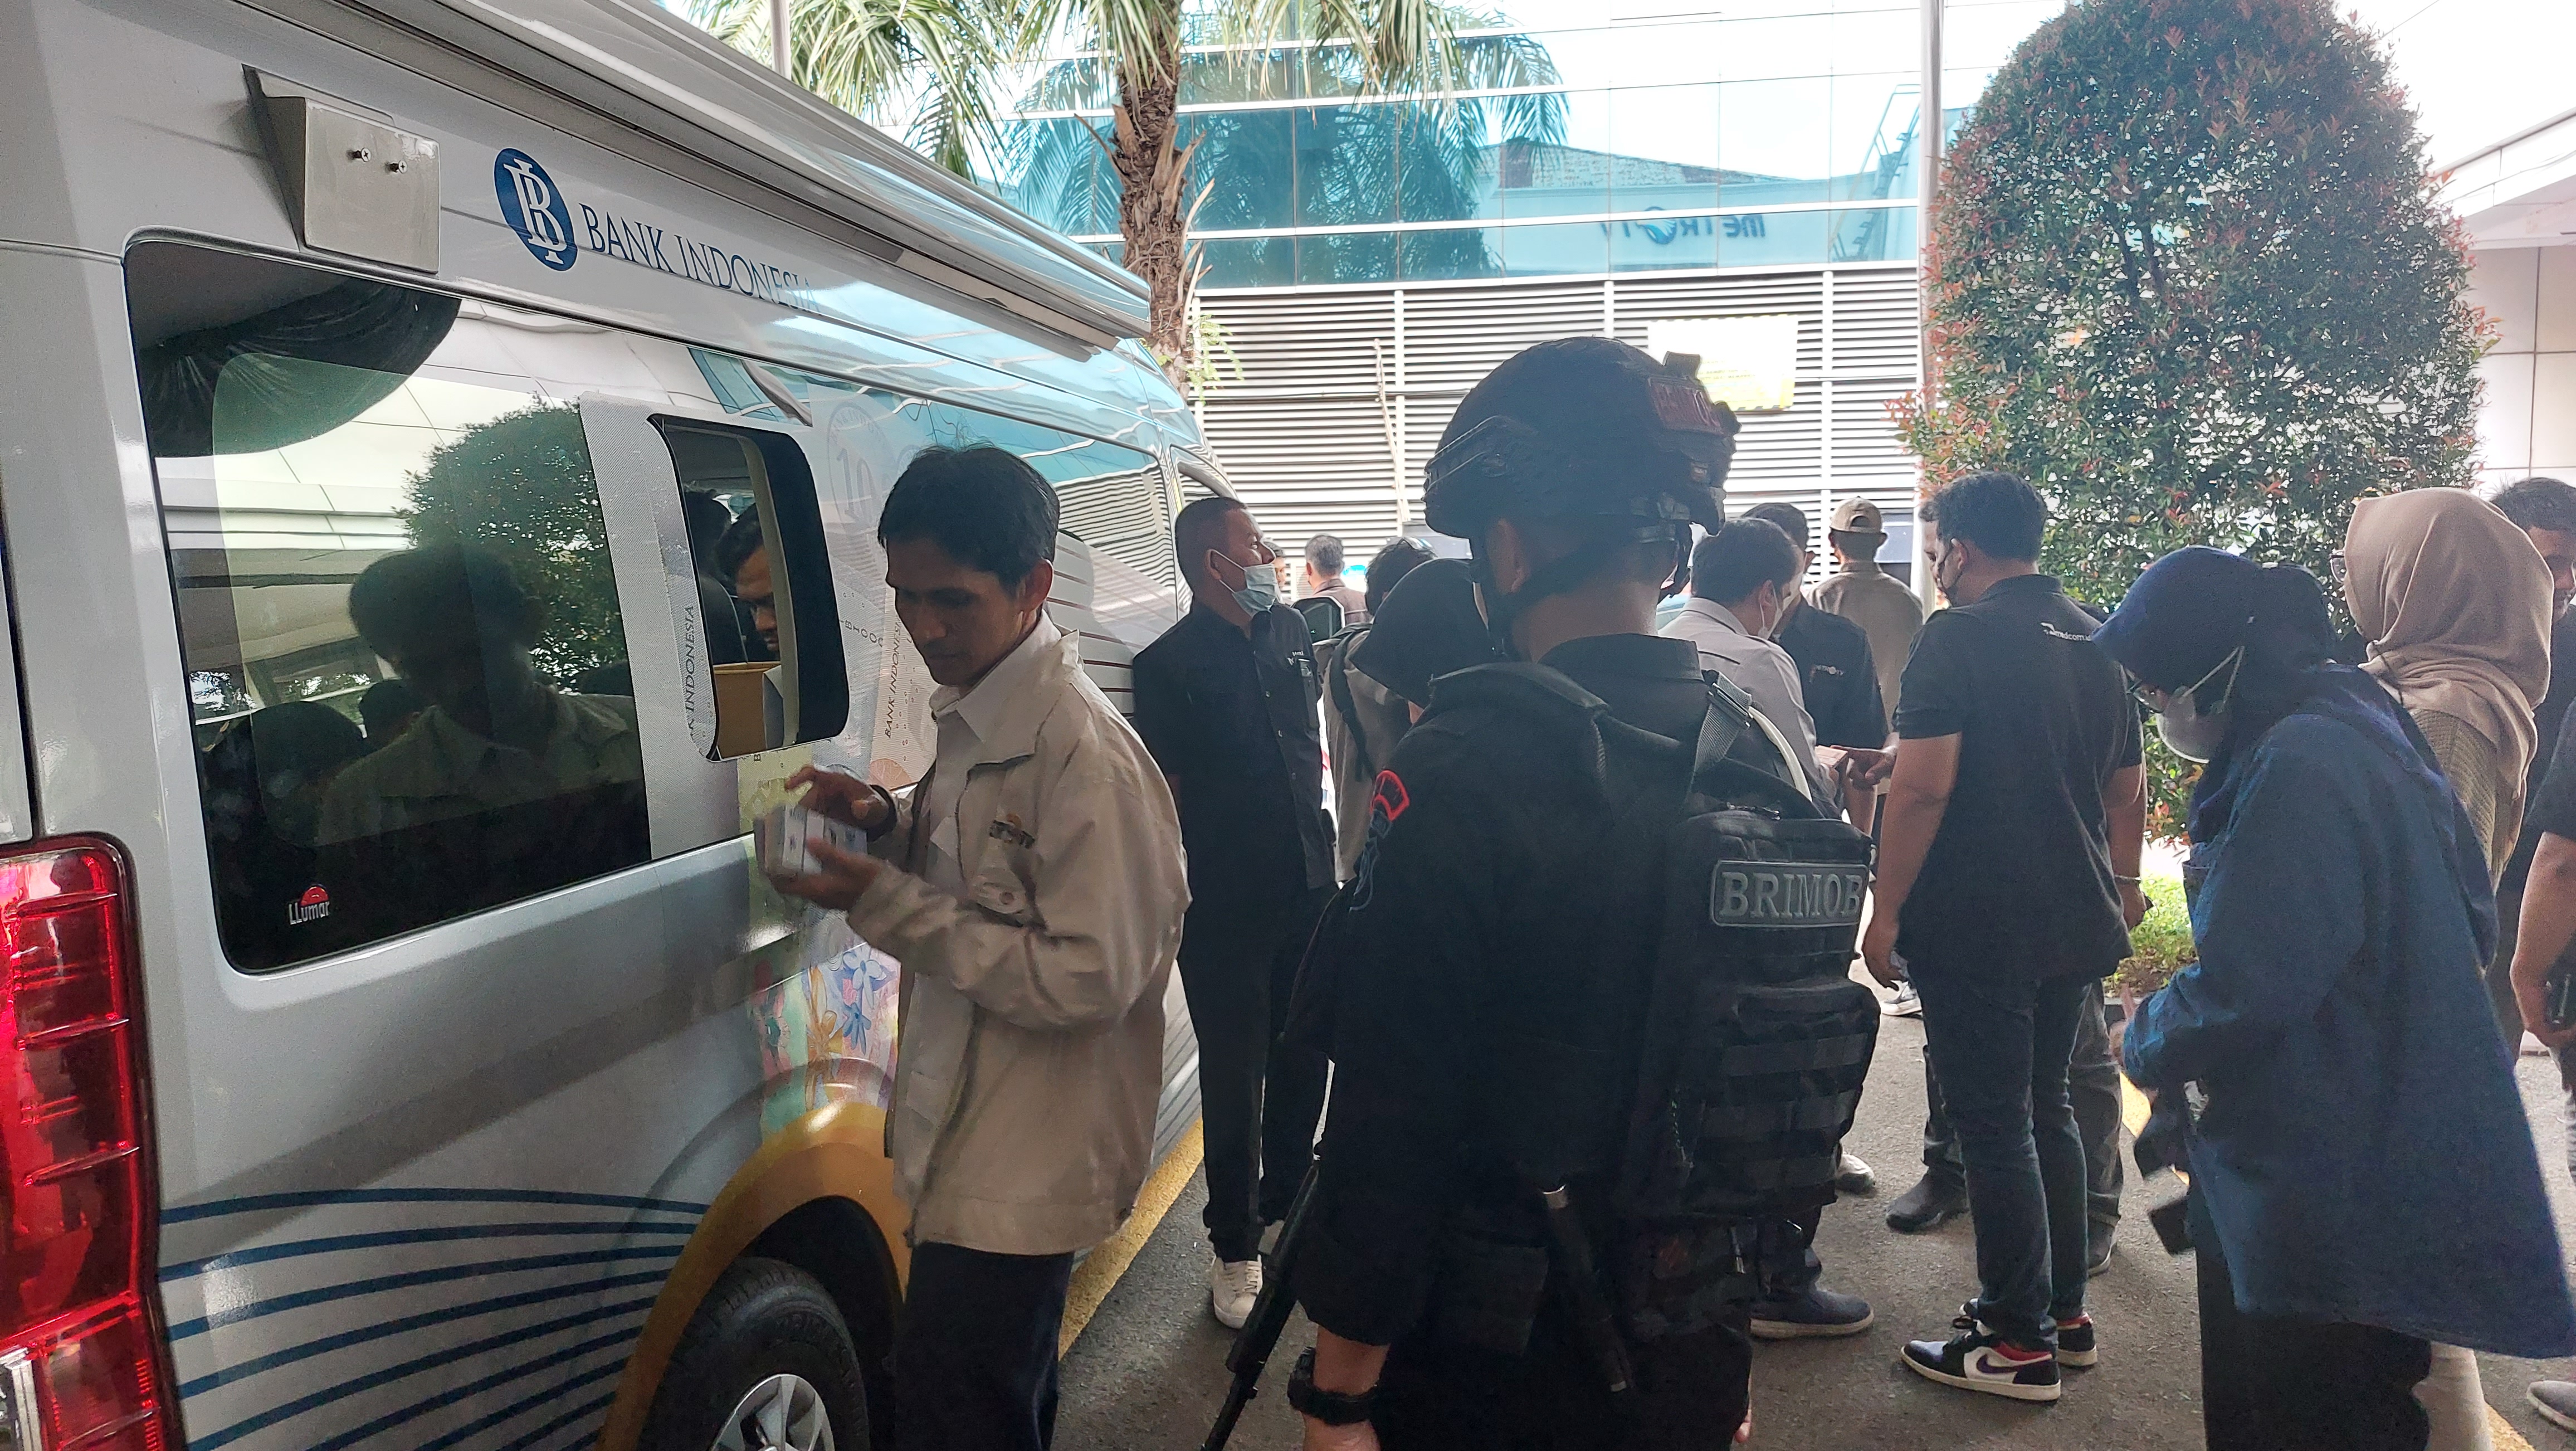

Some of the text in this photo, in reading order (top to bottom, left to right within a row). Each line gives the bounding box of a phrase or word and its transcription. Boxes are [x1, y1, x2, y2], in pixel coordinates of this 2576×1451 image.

[579, 202, 822, 313] BANK INDONESIA
[684, 605, 695, 713] INDONESIA
[884, 696, 895, 739] BANK
[287, 900, 330, 926] LLumar
[1719, 871, 1863, 919] BRIMOB
